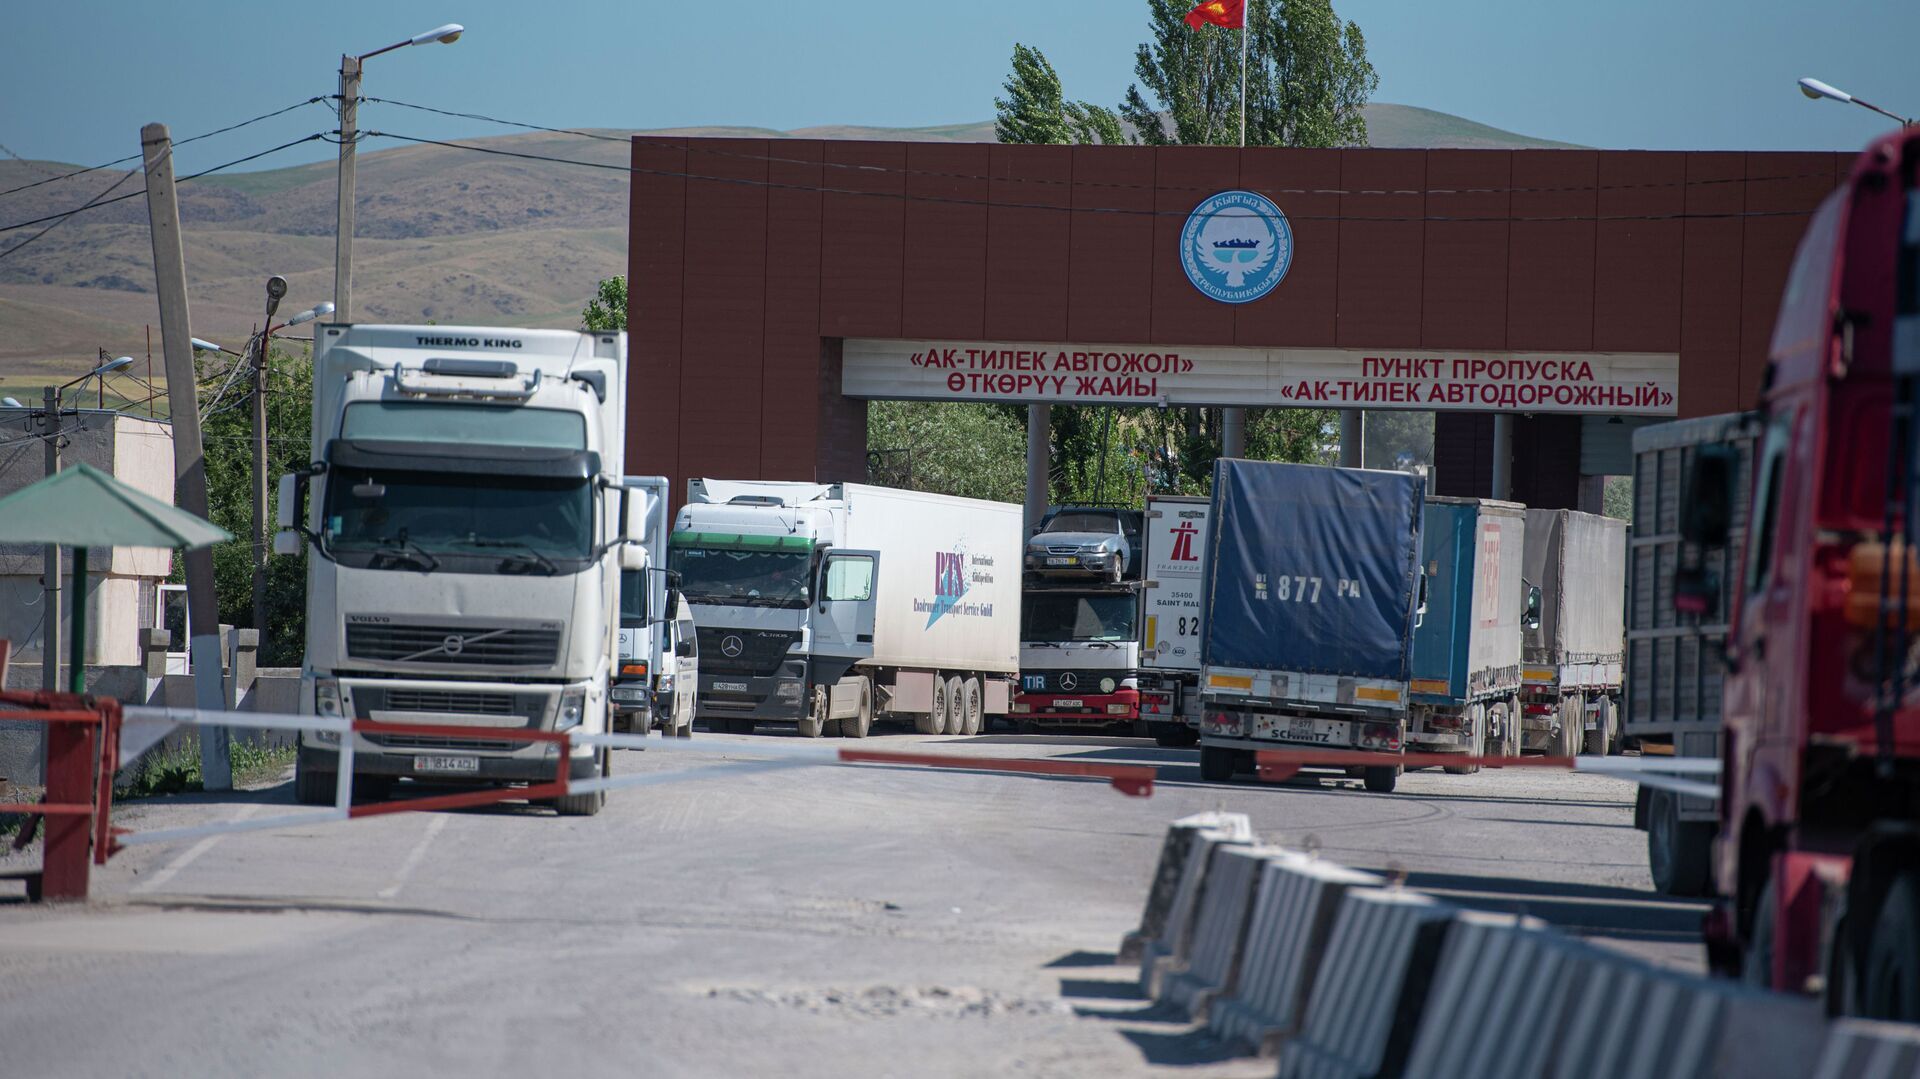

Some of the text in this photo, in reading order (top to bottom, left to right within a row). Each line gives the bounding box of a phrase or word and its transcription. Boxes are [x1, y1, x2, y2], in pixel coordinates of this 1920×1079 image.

[1214, 195, 1258, 208] КЫРГЫЗ
[1199, 278, 1272, 299] РЕСПУБЛИКАСЫ
[416, 336, 522, 348] THERMO KING
[910, 349, 1195, 374] «АК-ТИЛЕК АВТОЖОЛ»
[1362, 357, 1594, 382] ПУНКТ ПРОПУСКА
[946, 372, 1157, 397] ӨТКӨРҮҮ ЖАЙЫ
[1281, 381, 1674, 408] «АК-ТИЛЕК АВТОДОРОЖНЫЙ»
[935, 552, 964, 597] RTS
[1255, 591, 1268, 600] KG
[1278, 575, 1361, 603] 877 PA
[1156, 599, 1180, 607] SAINT
[351, 615, 390, 623] VOLVO
[1025, 675, 1045, 689] TIR
